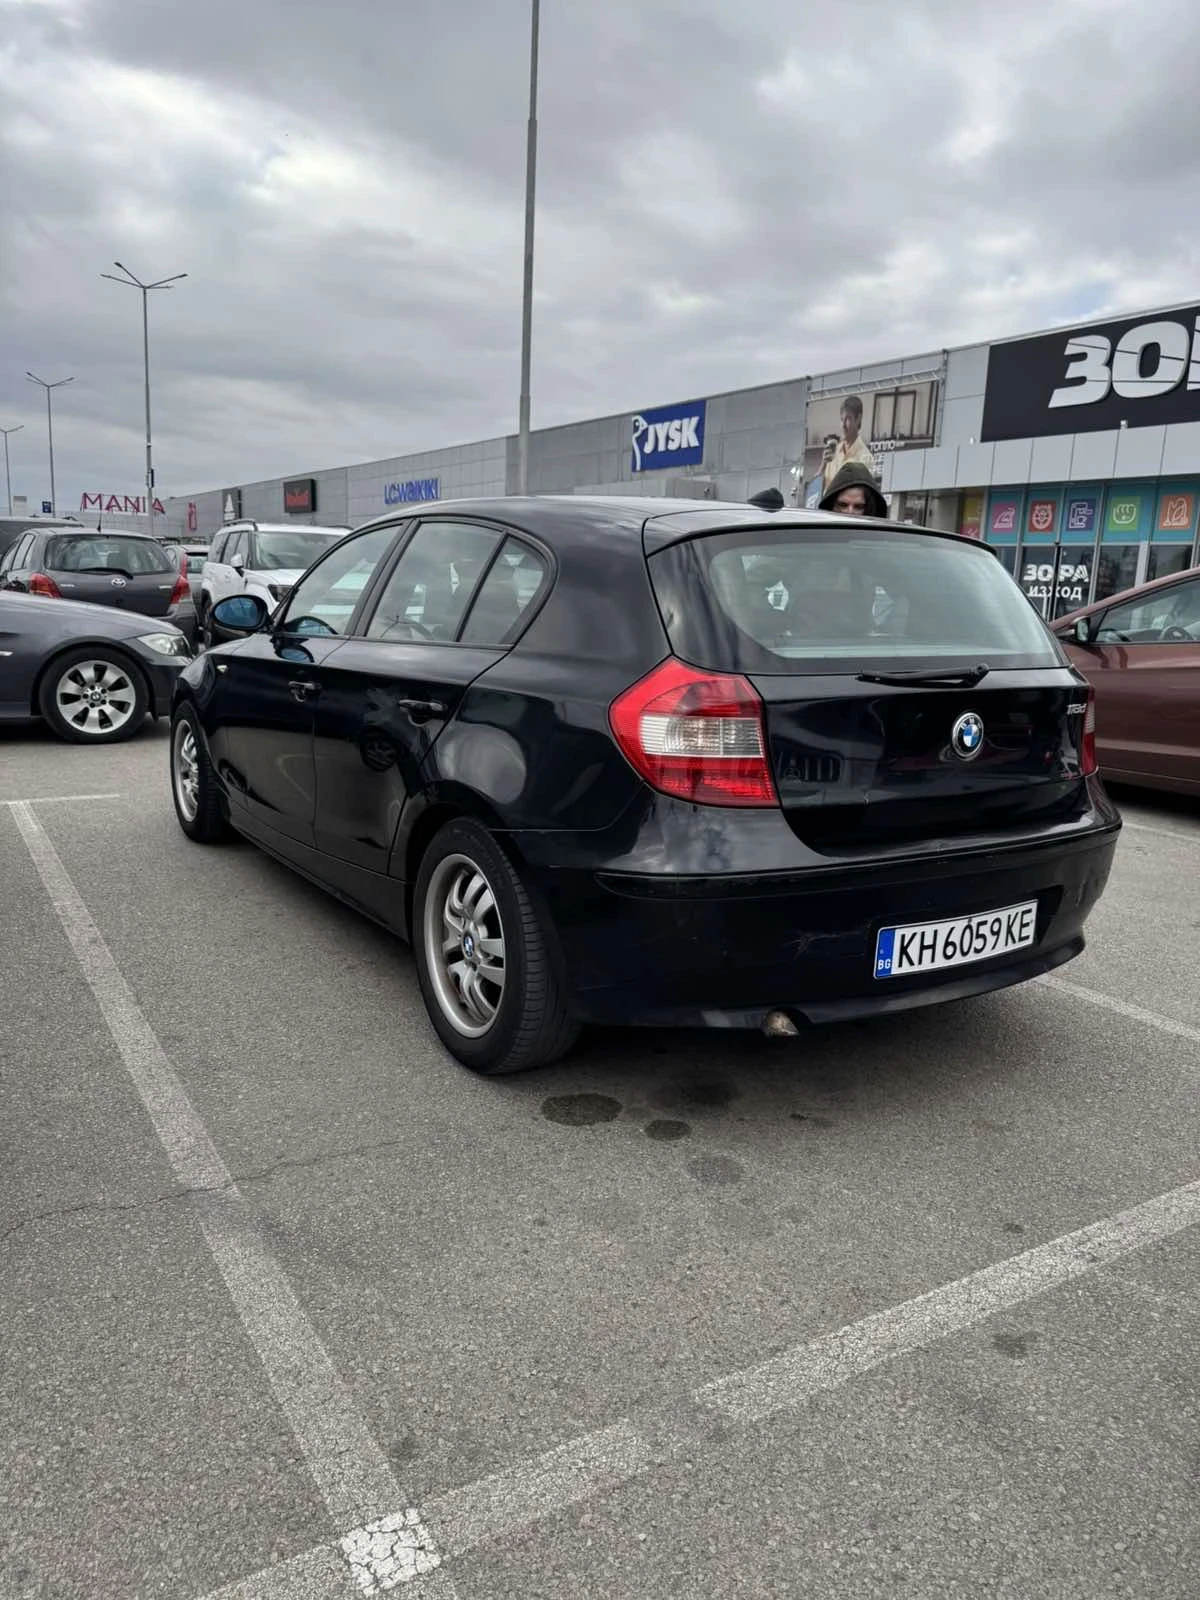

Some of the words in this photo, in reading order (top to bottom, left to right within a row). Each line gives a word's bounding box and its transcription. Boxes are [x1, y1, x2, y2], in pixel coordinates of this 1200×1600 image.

[1048, 315, 1200, 408] ЗО
[643, 416, 700, 454] JYSK
[81, 492, 165, 514] MANIA
[1023, 564, 1089, 582] ЗОРА
[877, 958, 892, 970] BG
